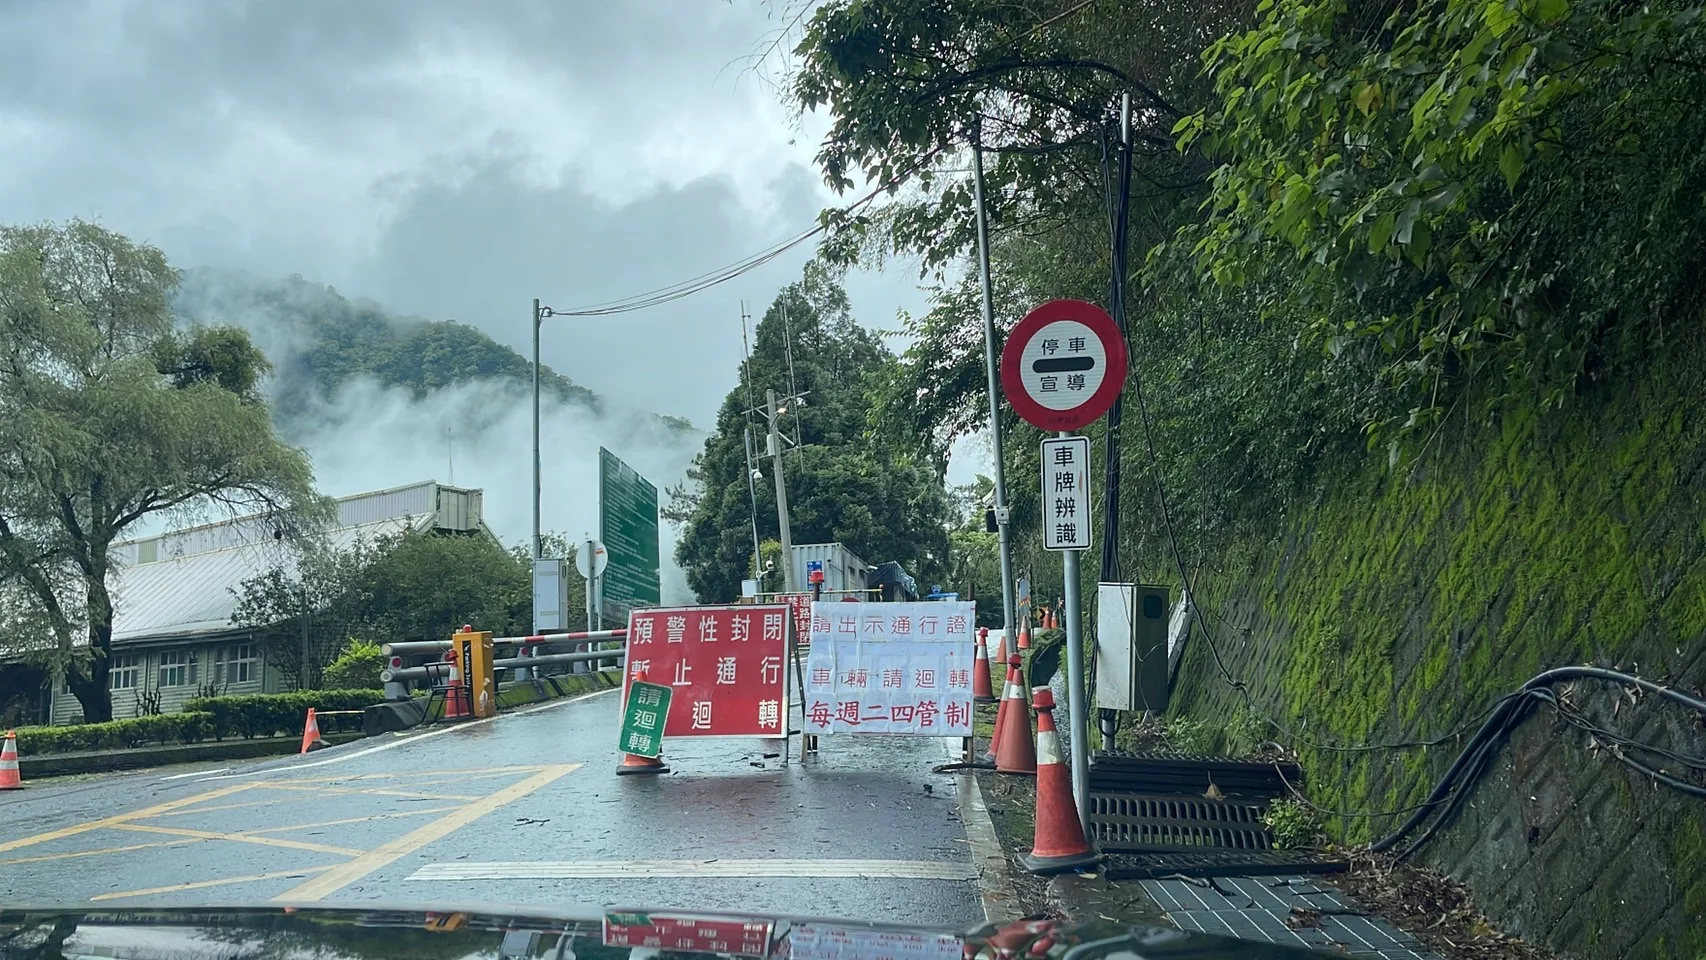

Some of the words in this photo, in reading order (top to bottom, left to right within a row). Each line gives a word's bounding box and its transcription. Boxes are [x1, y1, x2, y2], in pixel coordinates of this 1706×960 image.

[1041, 337, 1086, 355] 停車
[1040, 374, 1086, 393] 宣導
[1054, 446, 1076, 544] 車牌辨識
[633, 614, 783, 645] 預警性封閉
[812, 615, 967, 635] 請出示通行證
[811, 668, 969, 689] 車輛請迴轉
[627, 687, 662, 752] 請迴轉
[806, 700, 971, 729] 每週二四管制
